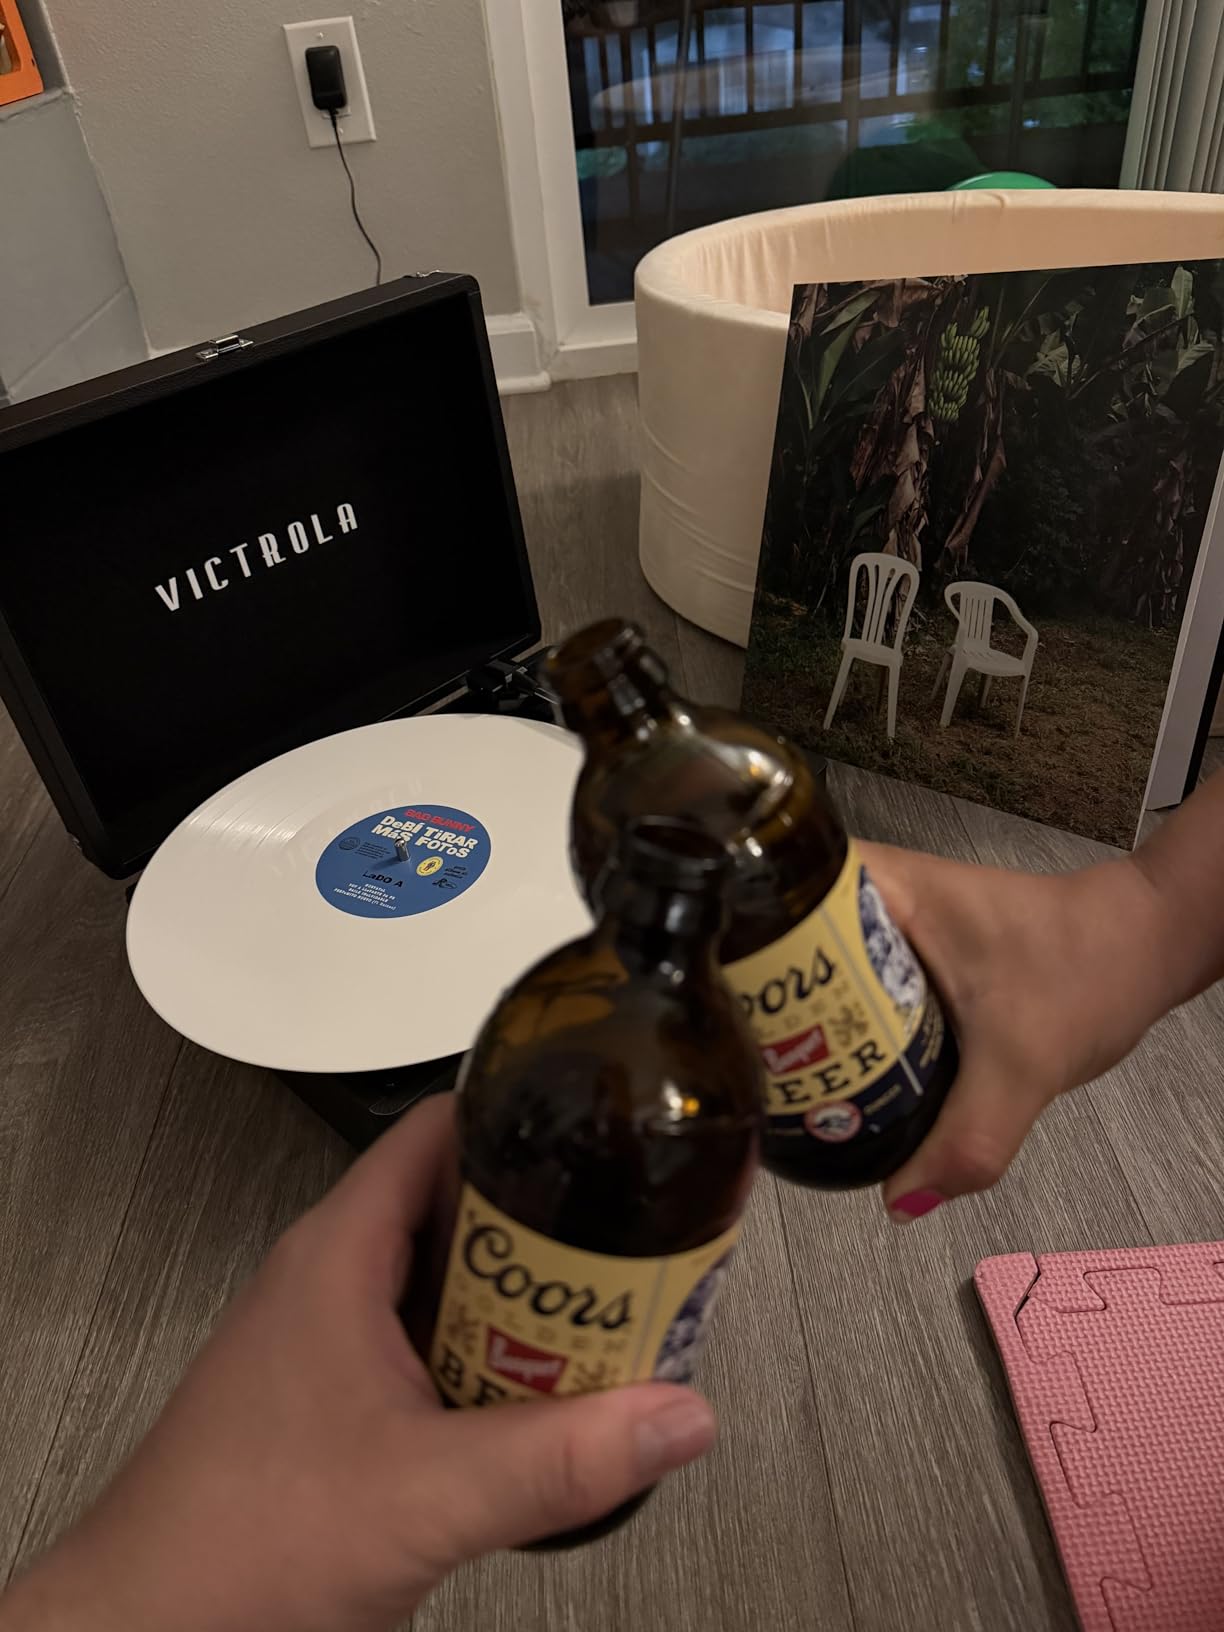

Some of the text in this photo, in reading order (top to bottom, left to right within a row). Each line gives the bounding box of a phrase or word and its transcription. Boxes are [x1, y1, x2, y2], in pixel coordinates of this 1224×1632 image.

[154, 502, 358, 612] VICTROLA
[768, 1039, 886, 1106] EER
[463, 1223, 634, 1330] Coors
